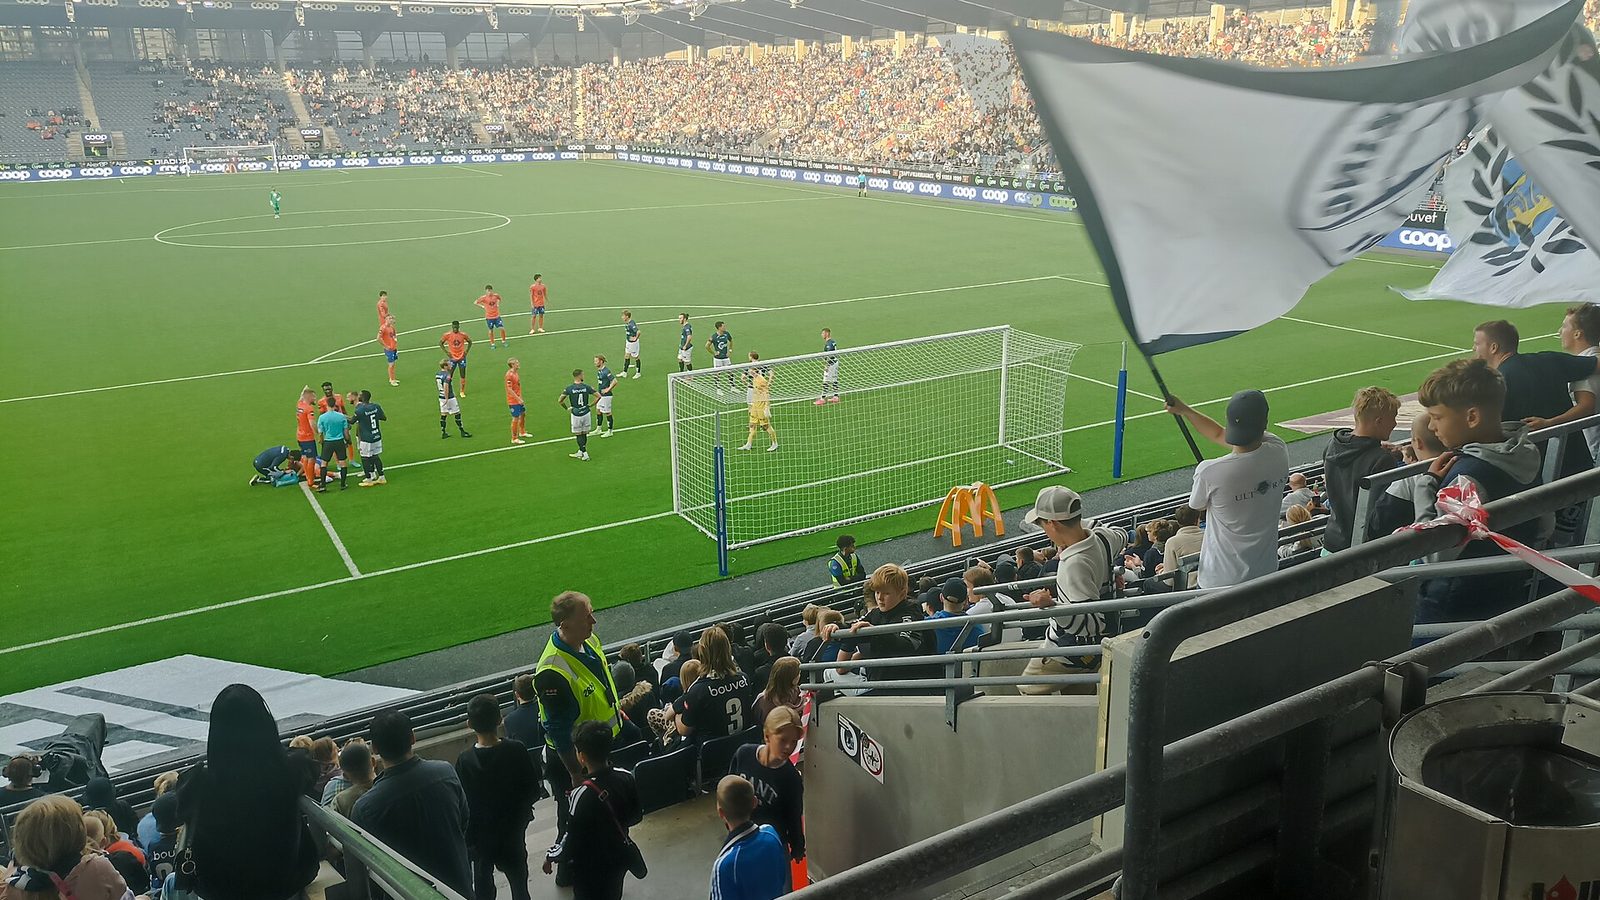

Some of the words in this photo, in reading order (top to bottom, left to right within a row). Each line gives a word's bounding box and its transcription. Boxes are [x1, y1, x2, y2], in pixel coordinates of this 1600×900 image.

[251, 2, 279, 10] coop
[310, 3, 338, 11] coop
[355, 4, 381, 12] coop
[409, 6, 434, 14] coop
[450, 7, 474, 15] coop
[508, 7, 532, 15] coop
[410, 156, 435, 164] coop
[441, 155, 466, 164] coop
[471, 154, 496, 162] coop
[501, 153, 525, 161] coop
[532, 152, 555, 160] coop
[308, 159, 336, 167] coop
[342, 158, 369, 167] coop
[378, 157, 404, 165] coop
[0, 170, 30, 180] oop
[39, 169, 72, 178] coop
[80, 167, 113, 176] coop
[120, 166, 152, 175] coop
[780, 169, 796, 180] coop
[803, 172, 820, 183] coop
[824, 173, 842, 185] coop
[868, 178, 888, 190] coop
[893, 181, 914, 193] coop
[919, 183, 941, 196] coop
[952, 186, 976, 200] coop
[982, 189, 1008, 203] coop
[1399, 229, 1451, 251] coop
[578, 394, 584, 406] 4
[370, 414, 377, 429] 5
[708, 675, 749, 697] bouvet
[725, 697, 744, 736] 3
[153, 851, 176, 861] bou
